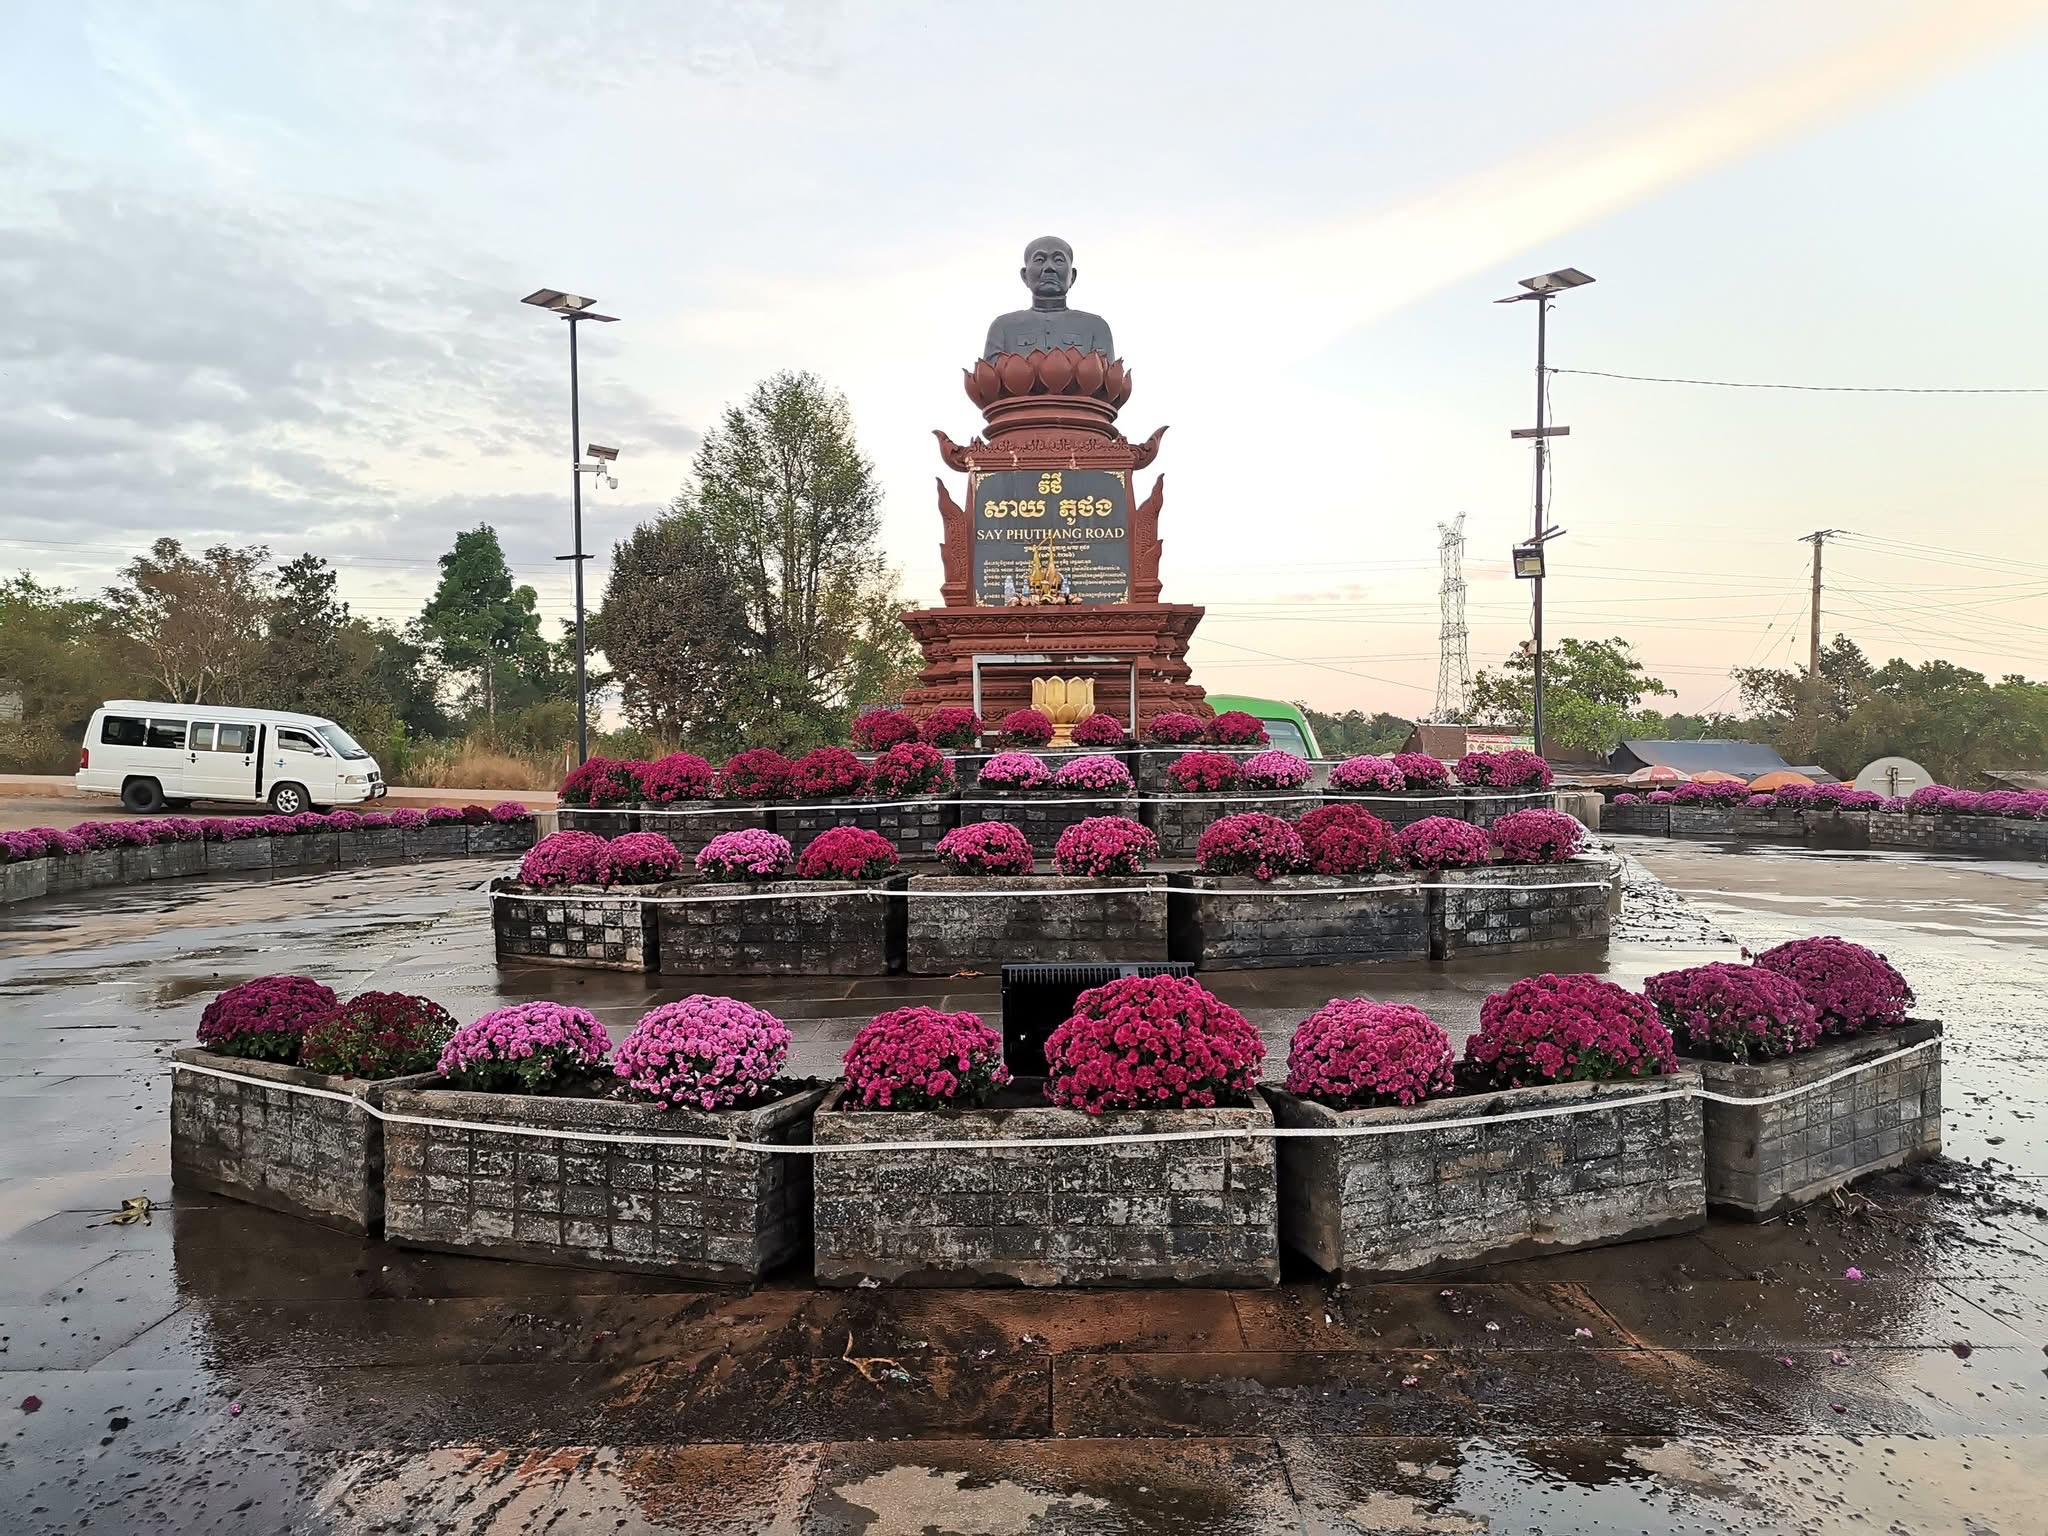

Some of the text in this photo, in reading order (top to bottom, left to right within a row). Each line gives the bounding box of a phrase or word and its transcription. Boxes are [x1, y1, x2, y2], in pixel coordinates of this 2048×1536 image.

[984, 496, 1113, 526] សាយ ភូថង
[976, 527, 1125, 541] SAY PHUTHANG ROAD
